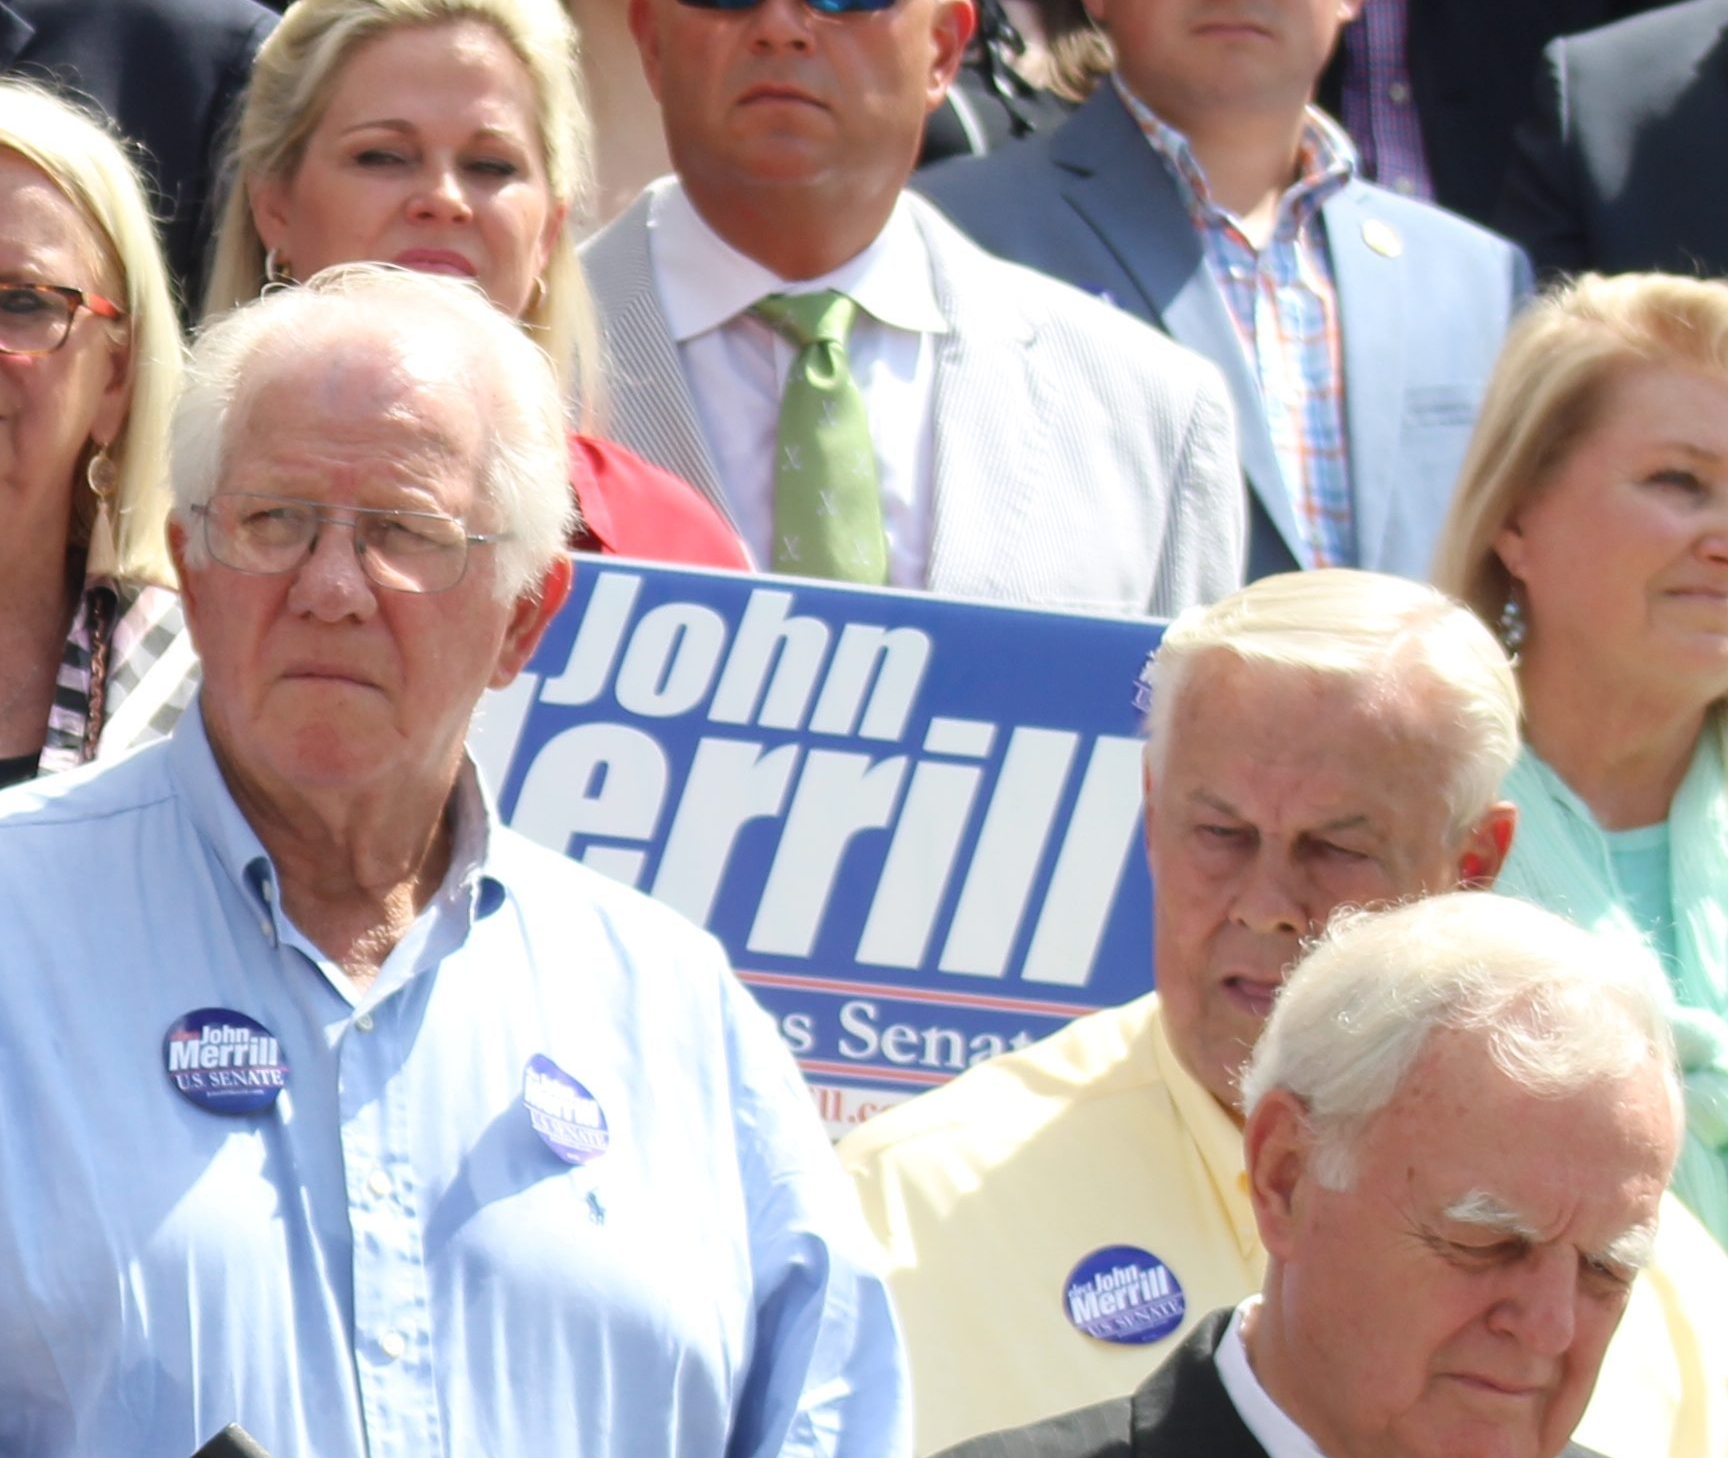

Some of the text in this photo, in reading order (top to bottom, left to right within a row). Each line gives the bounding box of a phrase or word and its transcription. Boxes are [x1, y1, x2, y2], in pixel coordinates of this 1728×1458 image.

[540, 572, 932, 742] John
[201, 1024, 250, 1044] John
[169, 1037, 279, 1071] Merrill
[208, 1070, 284, 1087] SENATE
[1094, 1264, 1139, 1293] John
[1071, 1265, 1170, 1325] Merrill
